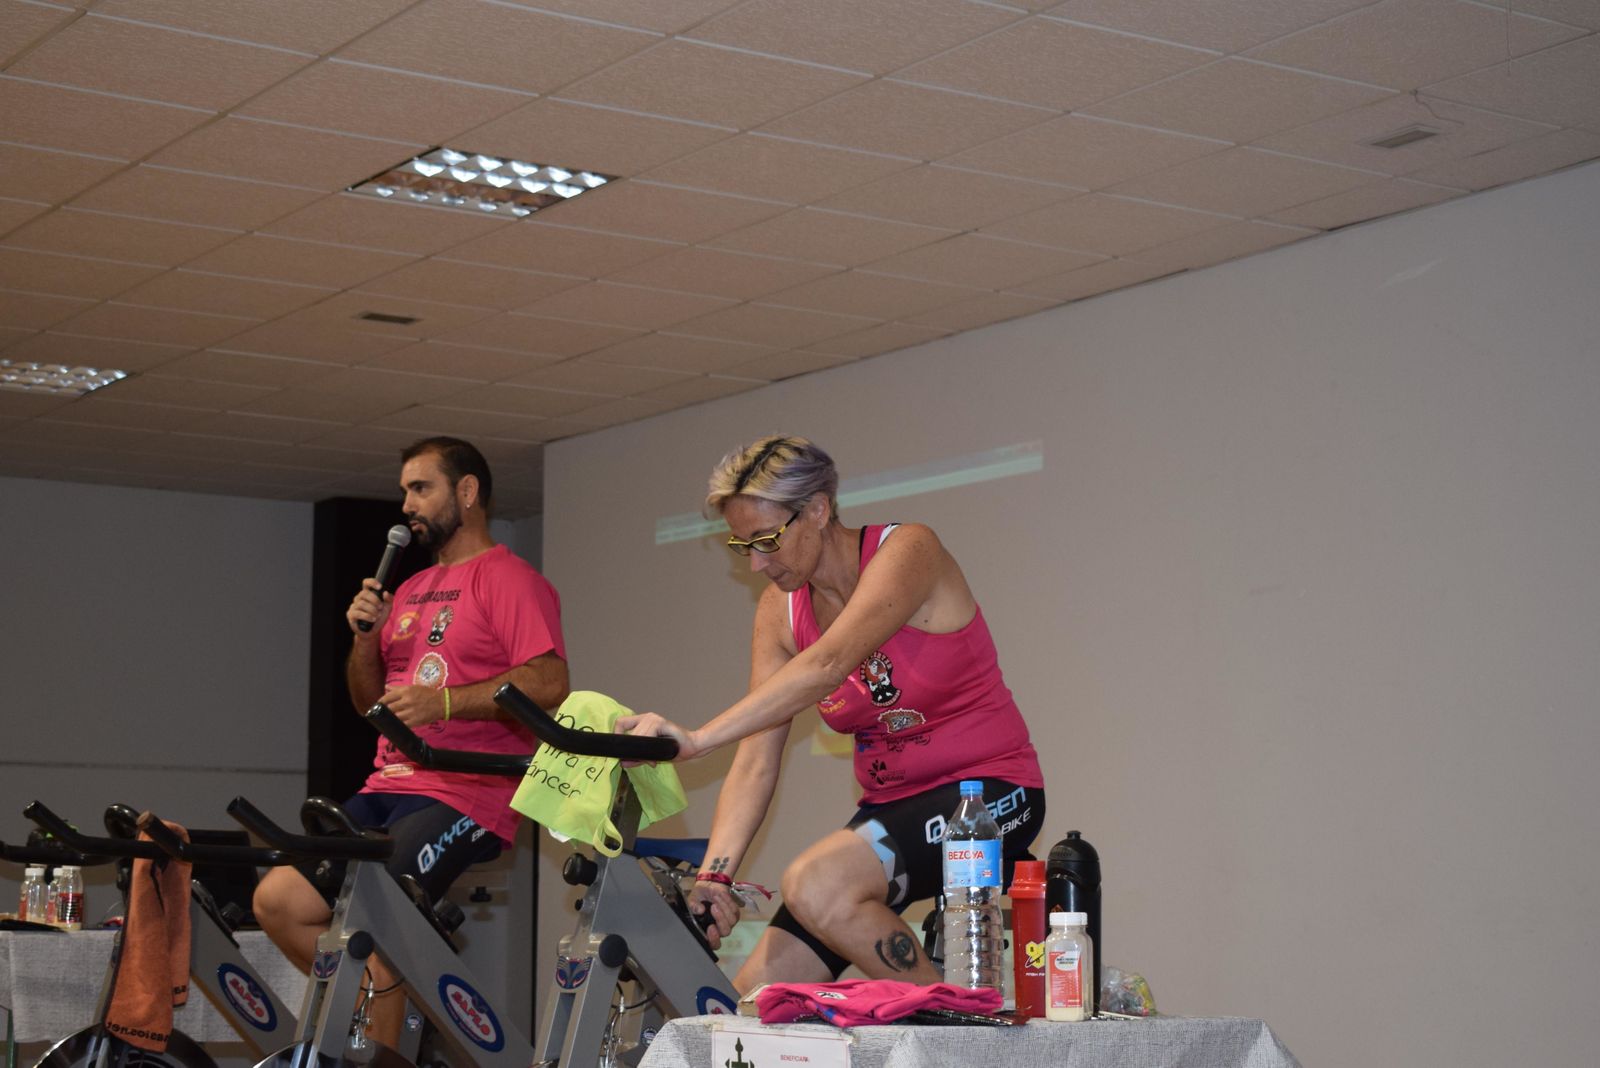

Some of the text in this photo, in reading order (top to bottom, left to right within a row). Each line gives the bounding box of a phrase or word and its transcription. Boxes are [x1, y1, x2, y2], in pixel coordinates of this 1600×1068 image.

[525, 761, 582, 799] áncer
[585, 767, 605, 783] el
[1000, 807, 1032, 836] BIKE
